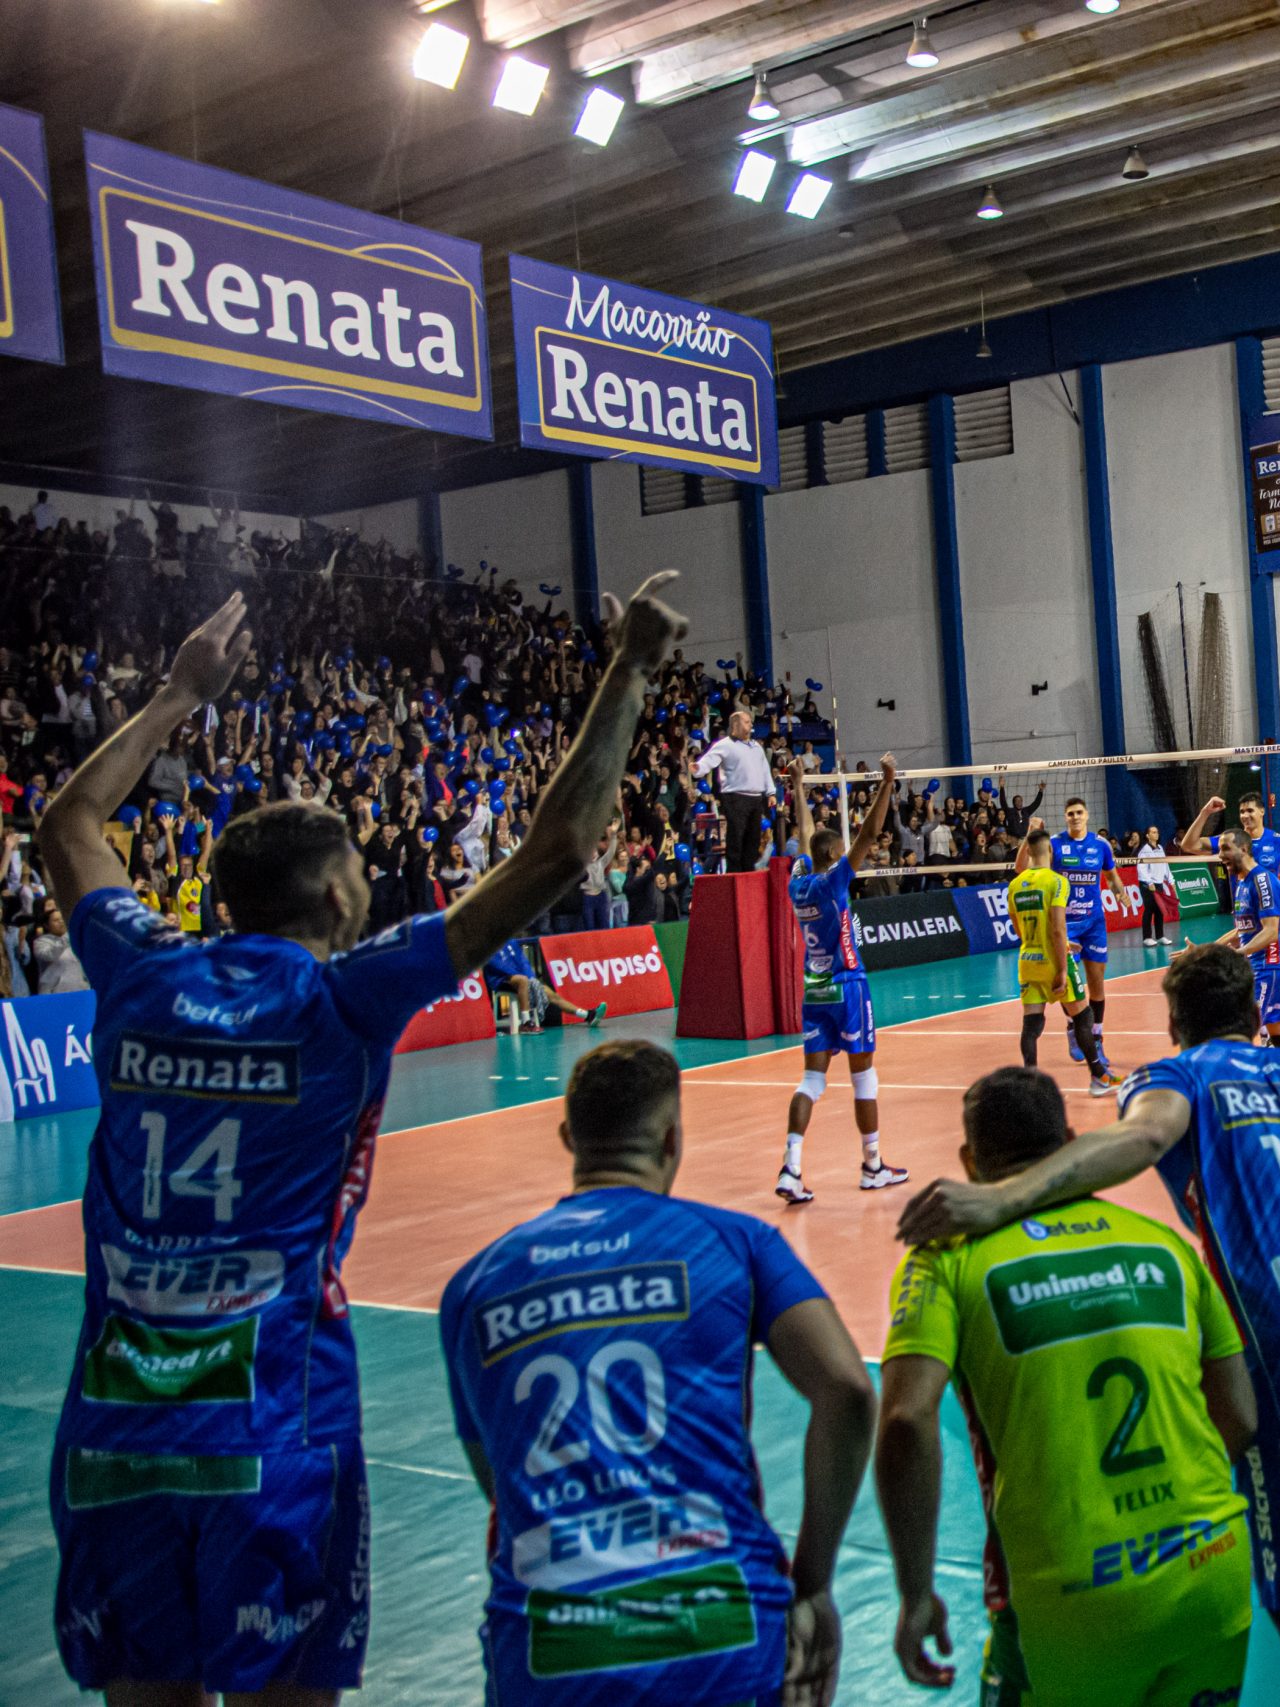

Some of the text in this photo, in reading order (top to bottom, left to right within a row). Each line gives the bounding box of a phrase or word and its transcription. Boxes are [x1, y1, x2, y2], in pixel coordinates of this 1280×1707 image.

[125, 219, 466, 378] Renata
[565, 275, 733, 359] Macarrão
[546, 343, 753, 453] Renata
[1048, 758, 1097, 767] CAMPEONATO
[1235, 746, 1265, 754] MASTER
[1075, 887, 1085, 898] 18
[1177, 879, 1201, 890] Unimed
[863, 915, 962, 944] CAVALERA
[1023, 916, 1038, 941] 17
[549, 949, 661, 986] Playpiso
[172, 992, 258, 1027] betsul
[117, 1039, 288, 1090] Renata
[140, 1111, 243, 1222] 14
[1021, 1217, 1111, 1241] betsul
[530, 1232, 630, 1264] betsul
[120, 1257, 250, 1294] EVER
[1008, 1263, 1126, 1305] Unimed
[482, 1274, 678, 1350] Renata
[514, 1339, 666, 1478] 20
[1086, 1356, 1166, 1477] 2
[1113, 1481, 1176, 1517] FELIX
[1093, 1519, 1215, 1589] EVER
[1188, 1532, 1237, 1571] EXPRESS
